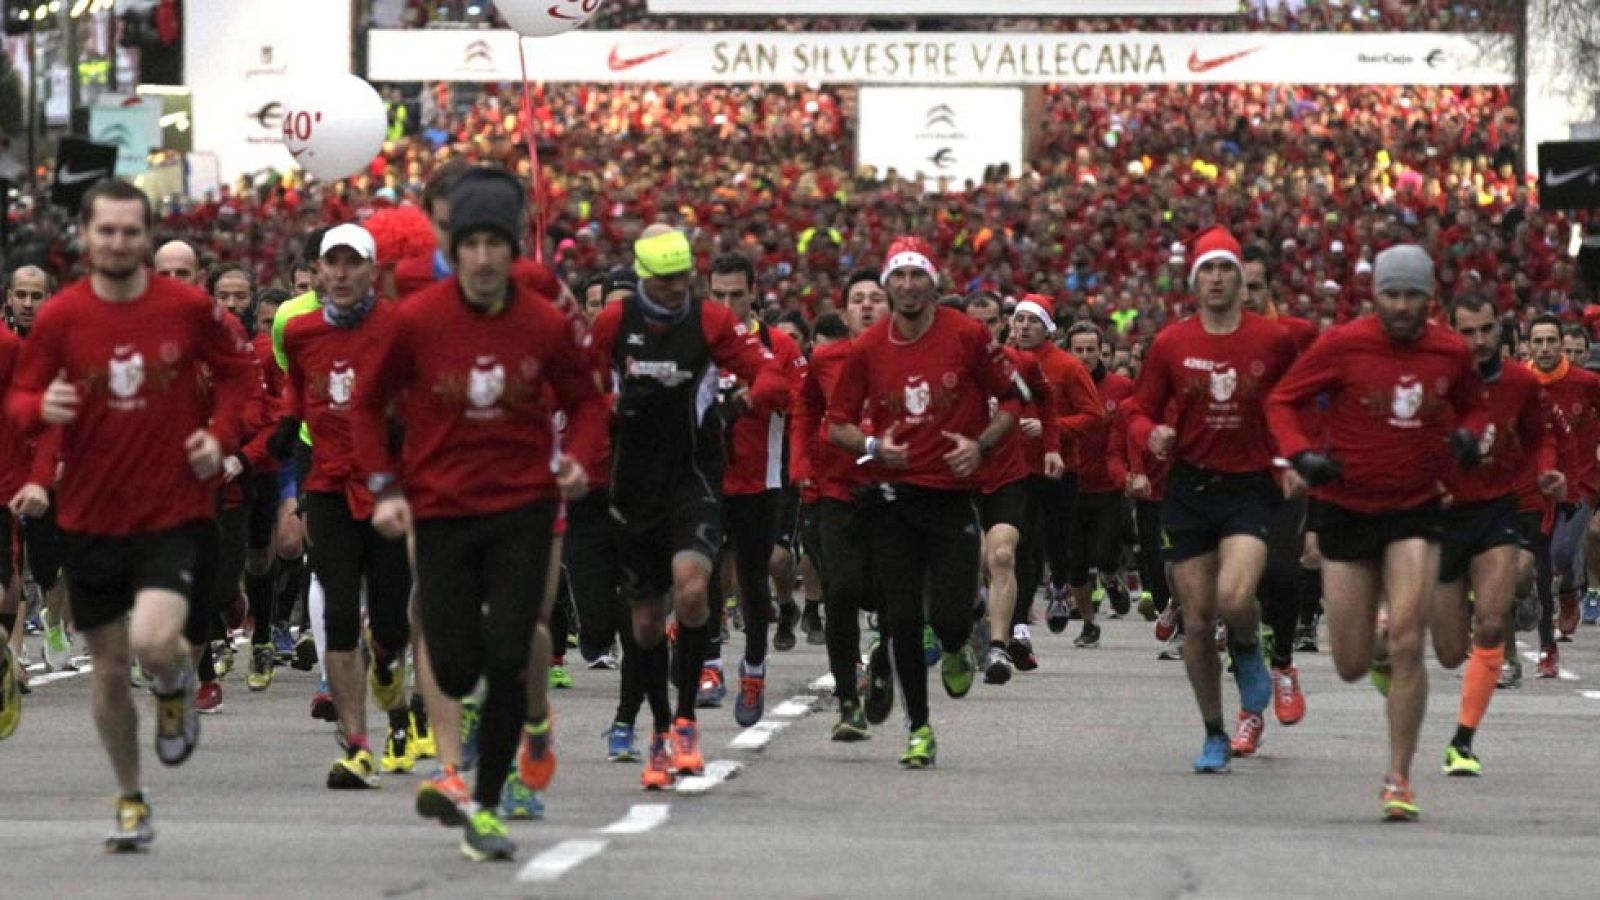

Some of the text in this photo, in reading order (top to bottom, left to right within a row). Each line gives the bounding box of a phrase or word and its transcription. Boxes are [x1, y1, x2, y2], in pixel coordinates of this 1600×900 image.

[711, 41, 1167, 75] SAN SILVESTRE VALLECANA
